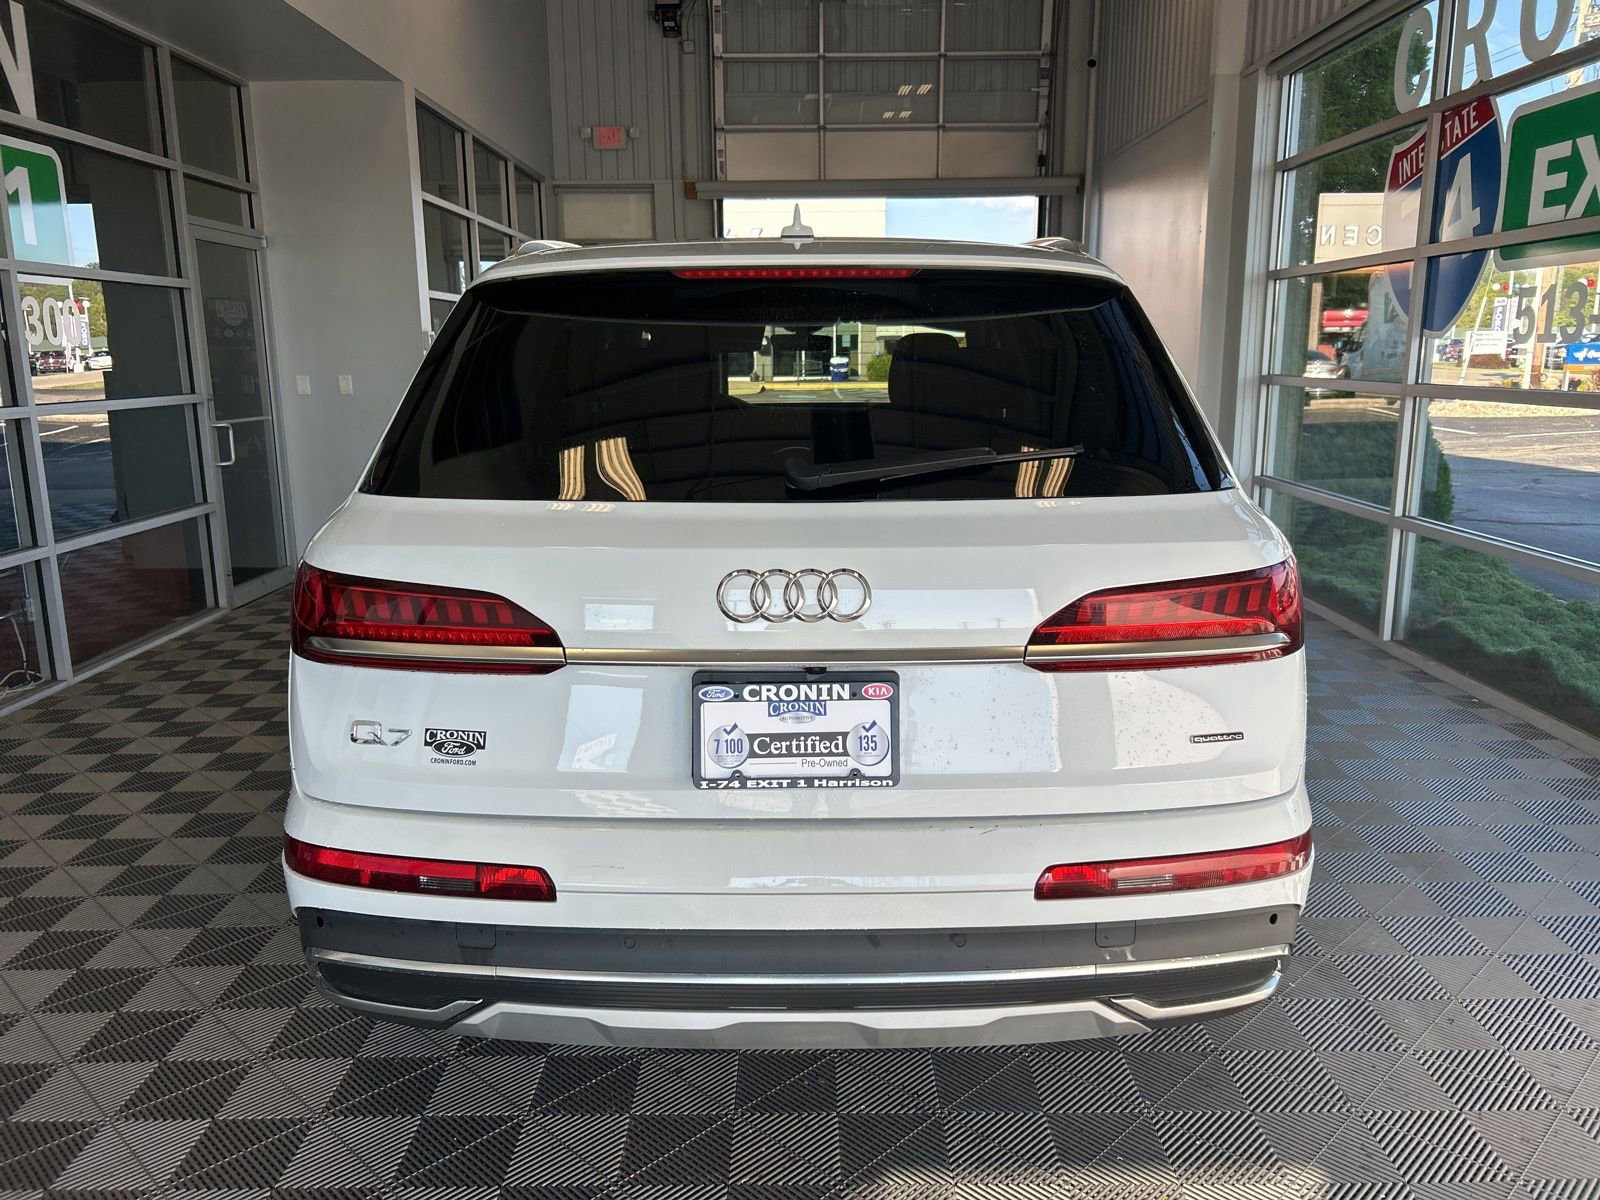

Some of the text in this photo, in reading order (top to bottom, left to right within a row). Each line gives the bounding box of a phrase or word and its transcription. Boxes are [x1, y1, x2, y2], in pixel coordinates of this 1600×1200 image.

[1398, 101, 1479, 185] INTETATE
[5, 165, 38, 246] 1
[0, 296, 81, 346] 300
[706, 688, 726, 698] Ford
[743, 684, 850, 701] CRONIN
[868, 687, 888, 696] KIA
[769, 701, 826, 716] CRONIN
[350, 720, 413, 747] Q7
[425, 729, 485, 747] CRONIN
[1193, 734, 1243, 743] quattro
[441, 742, 466, 756] Ford
[724, 738, 744, 754] 100
[753, 735, 844, 755] Certified
[857, 734, 878, 752] 135
[430, 757, 477, 767] CRONINFORD.COM
[801, 758, 848, 768] Pre-Owned
[700, 779, 893, 789] I-74 EXIT 1 Harrison
